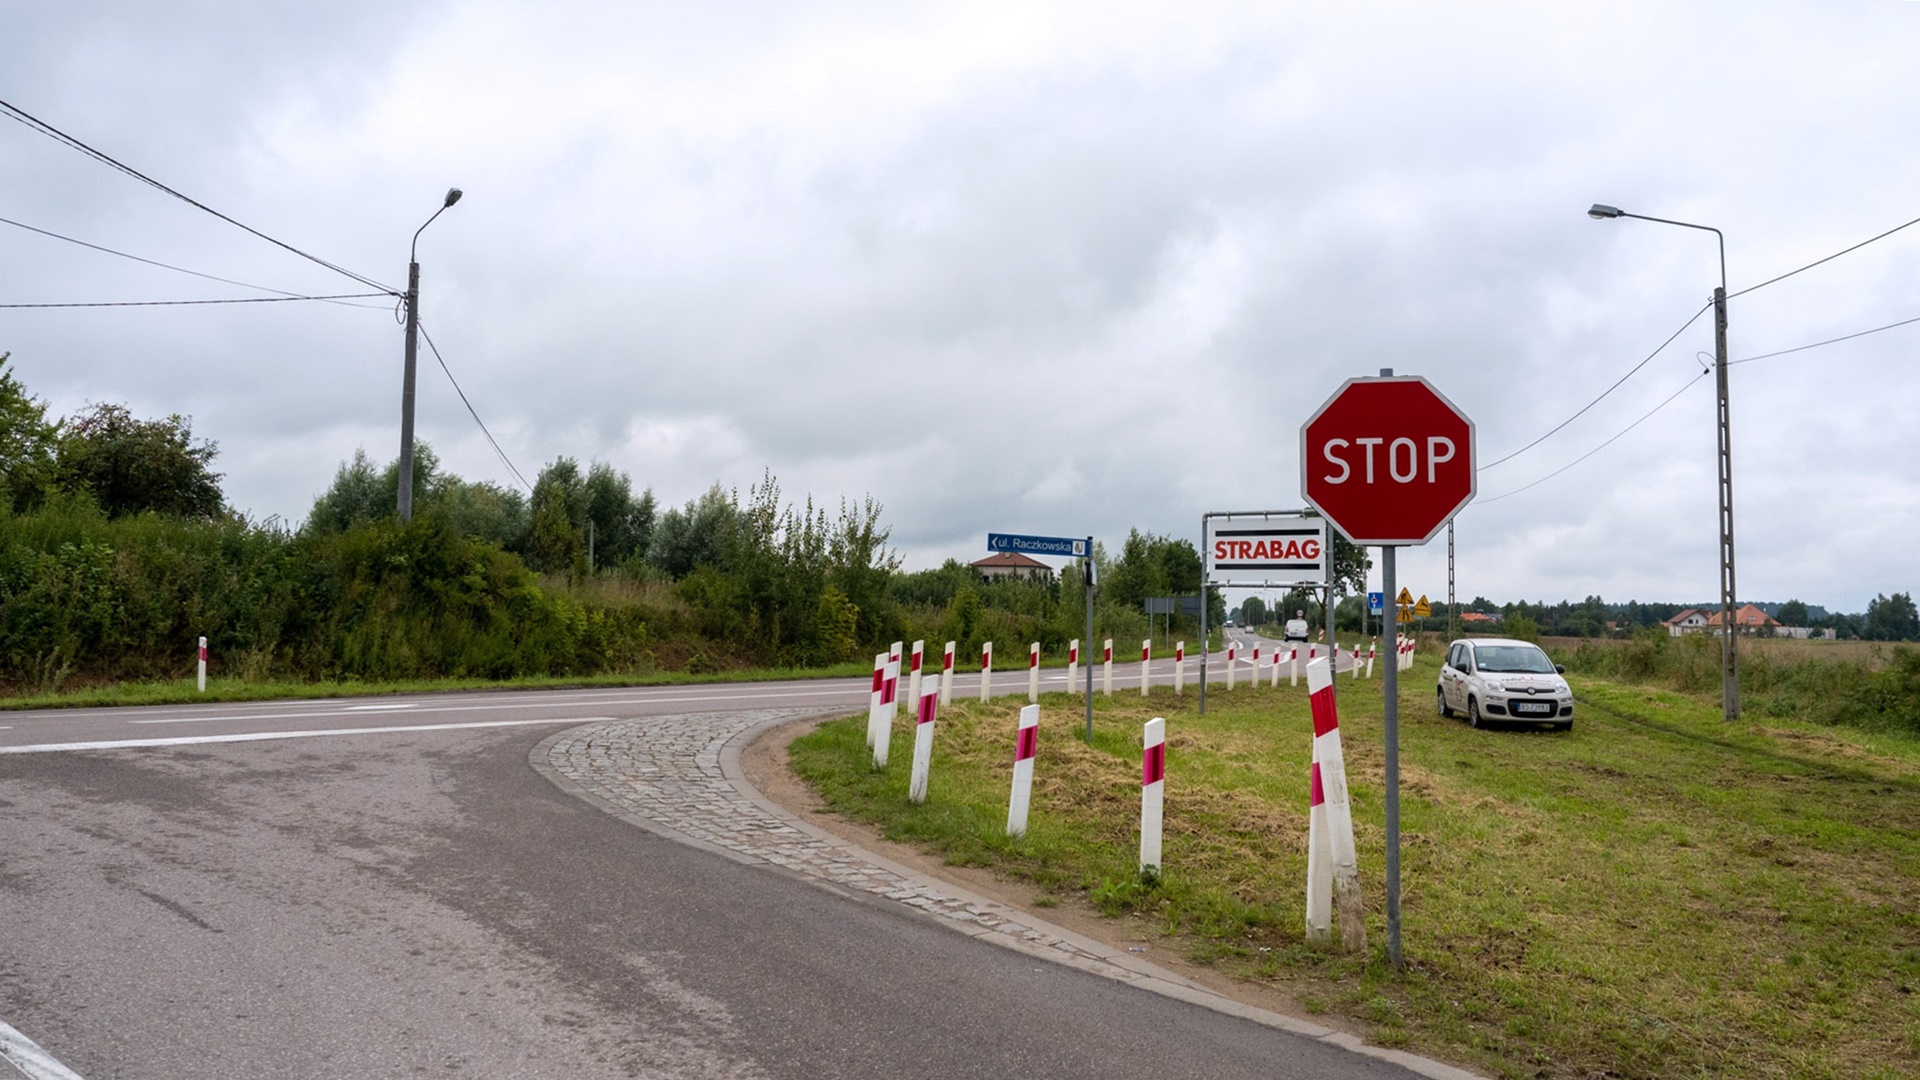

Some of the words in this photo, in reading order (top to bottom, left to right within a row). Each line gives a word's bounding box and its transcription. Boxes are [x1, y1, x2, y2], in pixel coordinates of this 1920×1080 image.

[1323, 436, 1456, 484] STOP
[998, 537, 1010, 548] ul.
[1013, 538, 1072, 552] Raczkowska
[1215, 539, 1320, 560] STRABAG
